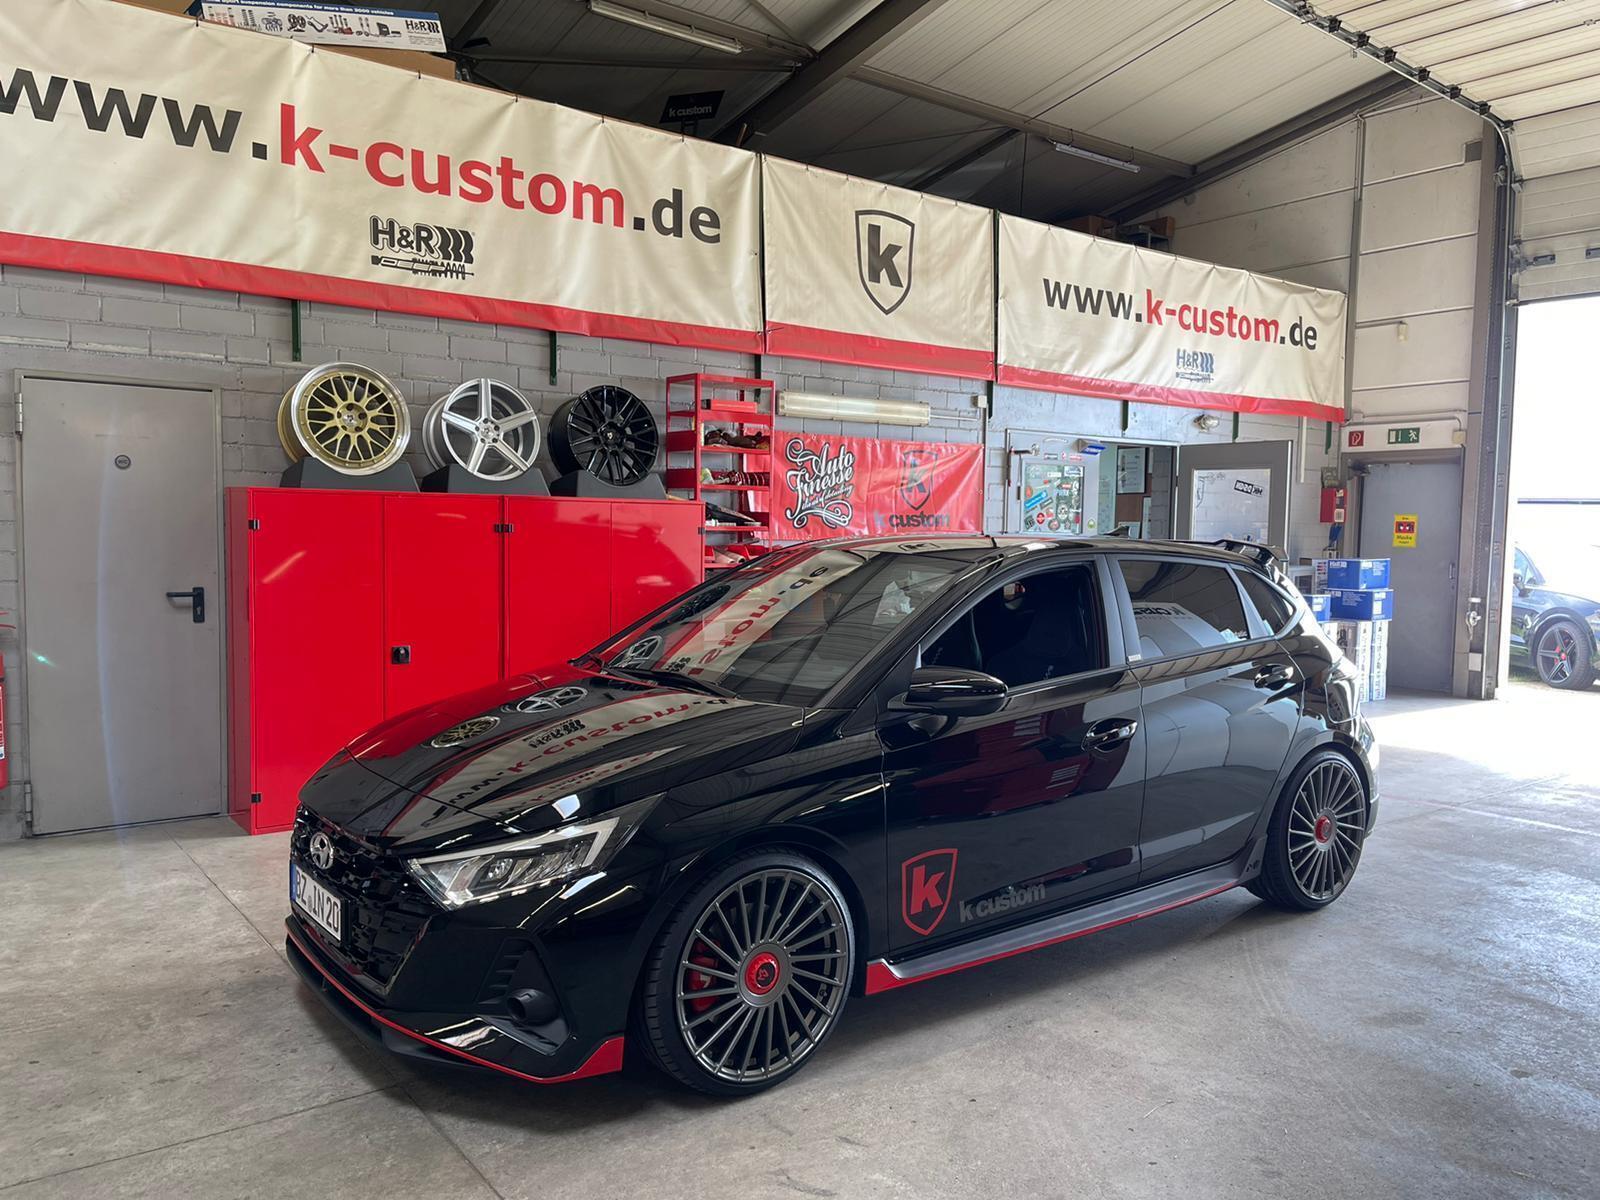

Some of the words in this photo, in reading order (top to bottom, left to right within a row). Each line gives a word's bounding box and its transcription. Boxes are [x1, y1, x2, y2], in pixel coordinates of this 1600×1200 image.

[405, 19, 433, 33] H&R
[676, 105, 713, 117] custom
[0, 67, 721, 244] www.k-custom.de
[370, 215, 452, 262] H&R
[1042, 277, 1319, 351] www.k-custom.de
[1176, 348, 1204, 372] H&R
[795, 440, 855, 478] Auto
[786, 464, 855, 512] Finesse
[888, 509, 951, 528] custom
[326, 895, 340, 934] 20
[959, 900, 974, 924] k
[975, 882, 1047, 917] custom
